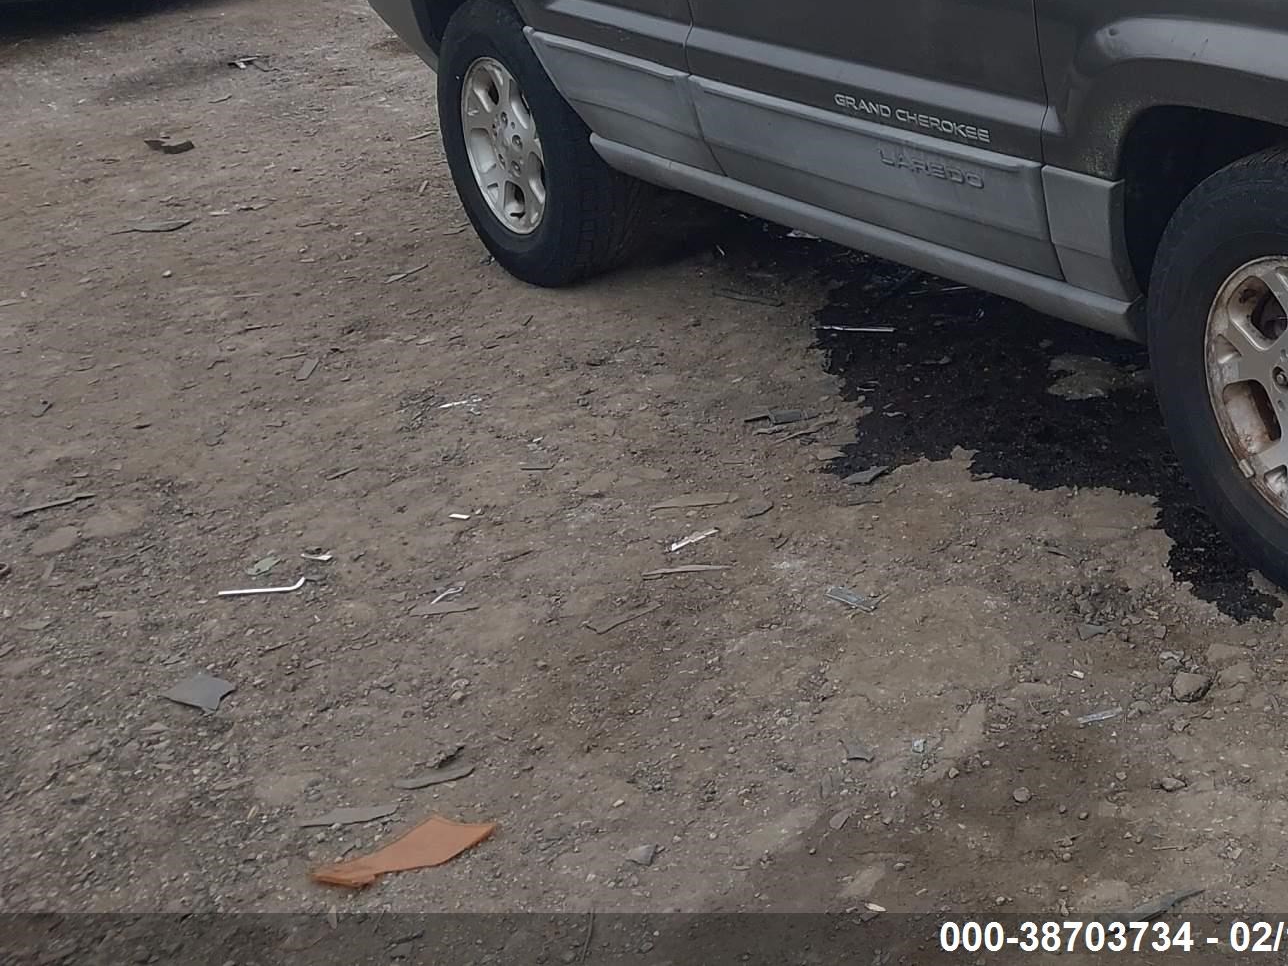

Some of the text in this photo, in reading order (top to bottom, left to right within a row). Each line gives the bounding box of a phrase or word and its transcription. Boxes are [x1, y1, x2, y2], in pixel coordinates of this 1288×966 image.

[834, 93, 991, 143] GRAND CHEROKEE
[879, 148, 985, 189] LAREDO
